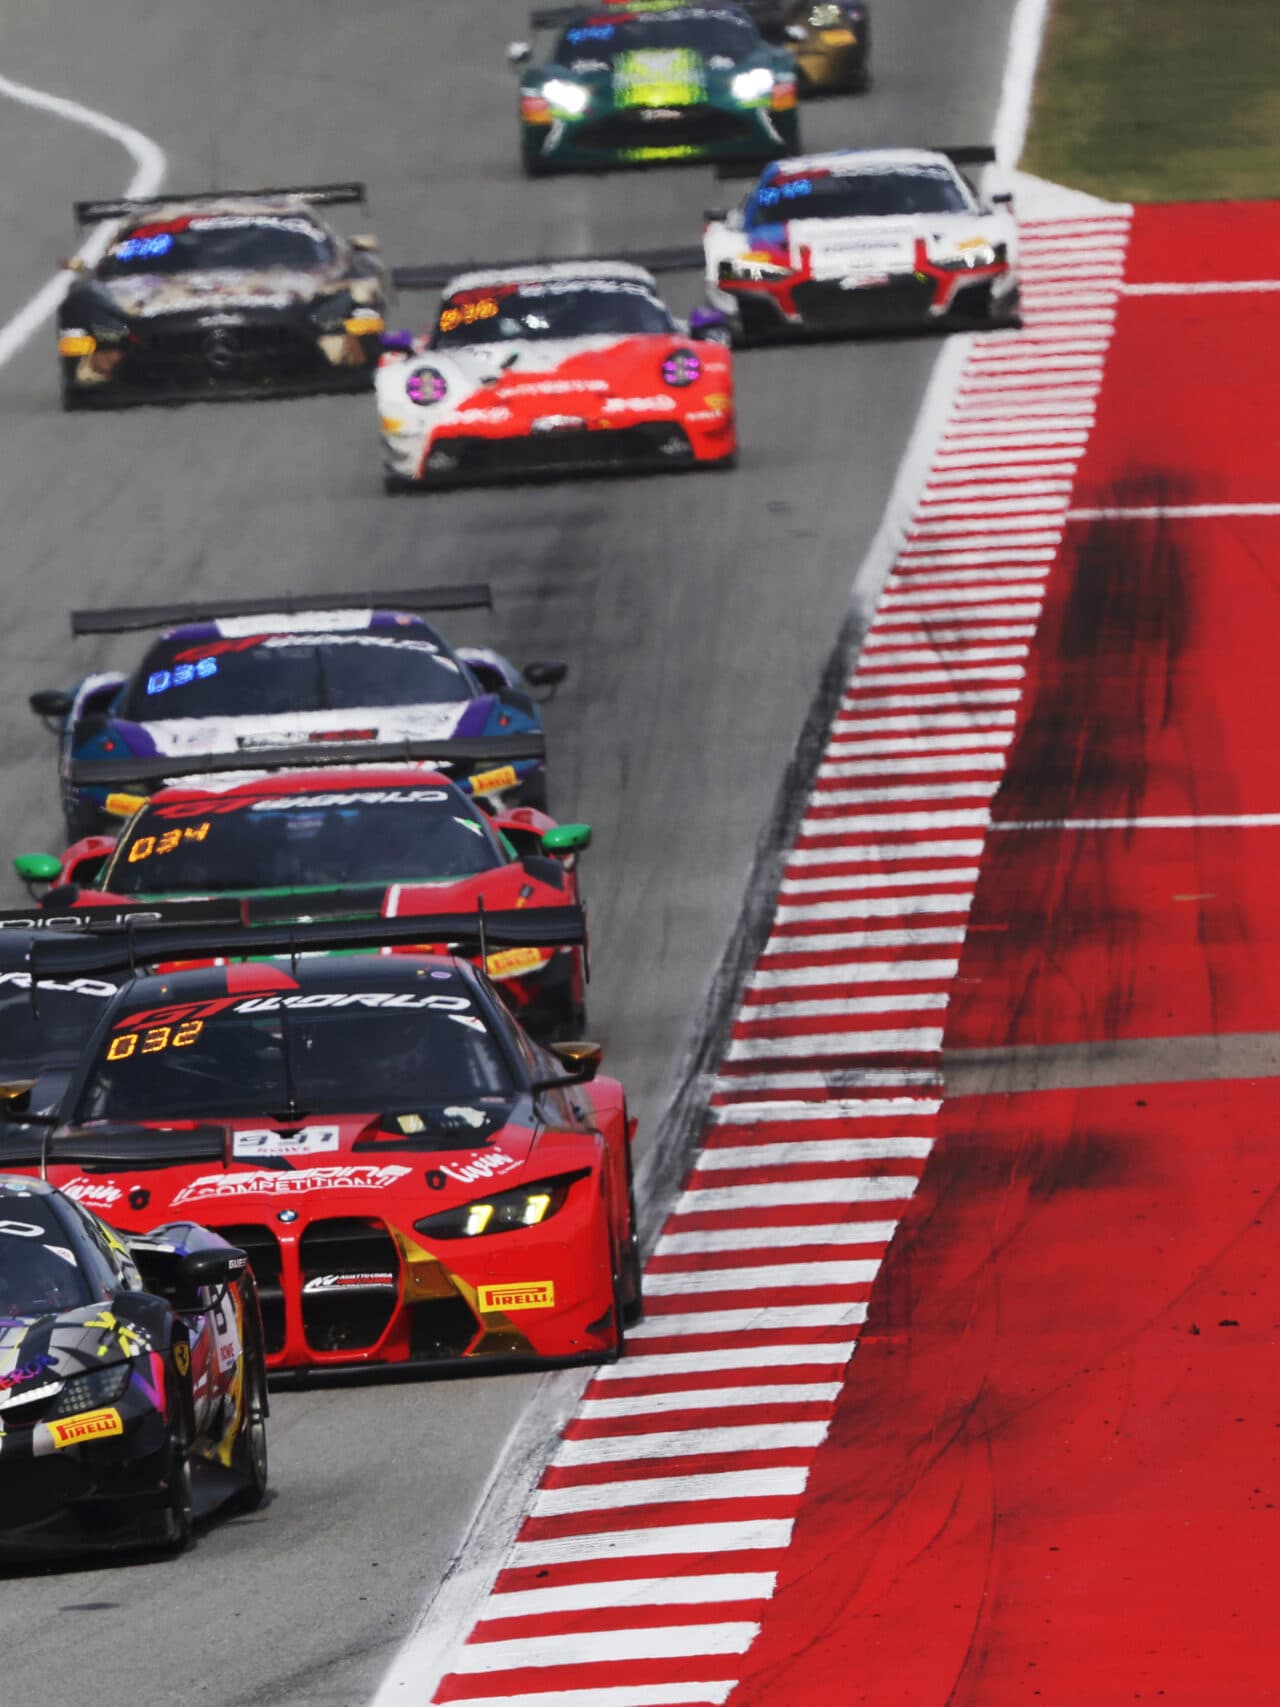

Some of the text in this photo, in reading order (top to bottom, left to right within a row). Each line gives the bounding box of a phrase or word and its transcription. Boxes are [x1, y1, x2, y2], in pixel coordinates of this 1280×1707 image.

[128, 822, 210, 862] 034
[113, 992, 473, 1031] GT WORLD
[107, 1020, 203, 1061] 032
[198, 1175, 377, 1197] COMPETITION
[485, 1286, 547, 1306] PIRELLI
[56, 1413, 117, 1441] PIRELLI
